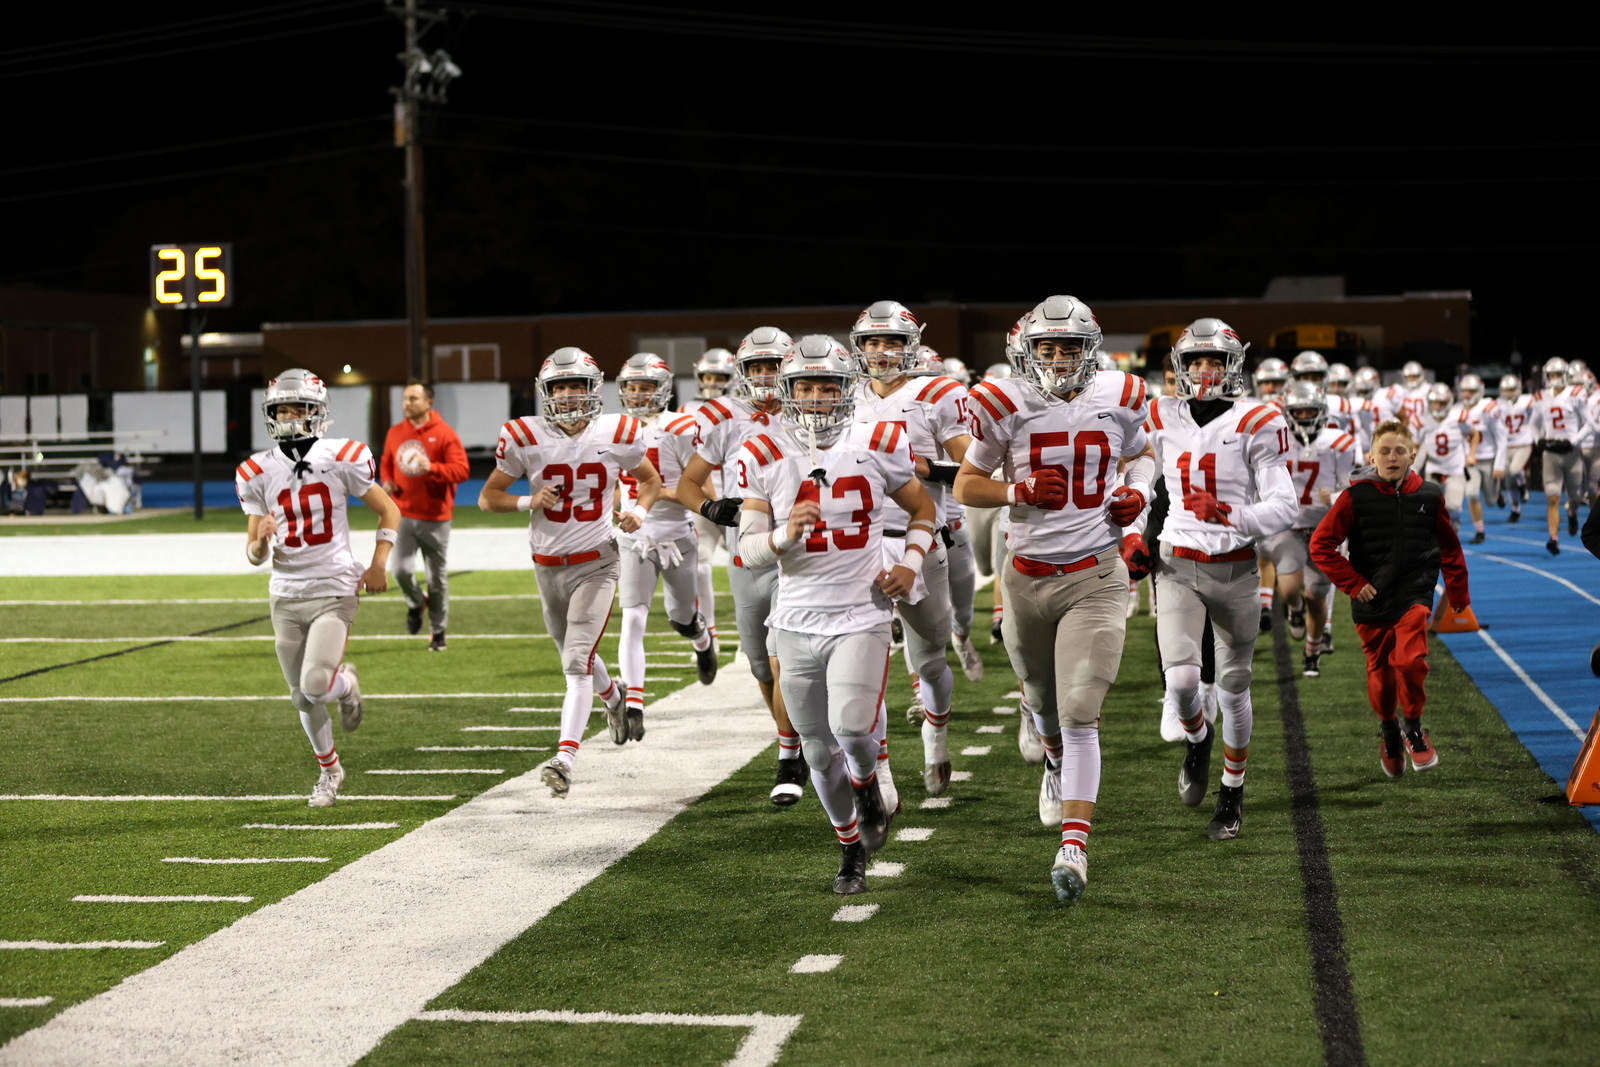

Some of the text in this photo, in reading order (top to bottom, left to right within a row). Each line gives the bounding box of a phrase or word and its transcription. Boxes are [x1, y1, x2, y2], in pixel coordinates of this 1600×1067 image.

[155, 246, 225, 303] 25
[1435, 433, 1449, 456] 8
[1550, 406, 1566, 430] 2
[543, 462, 607, 523] 33
[1030, 430, 1111, 511] 50
[1176, 451, 1218, 512] 11
[1287, 460, 1320, 505] 7
[277, 481, 334, 547] 10
